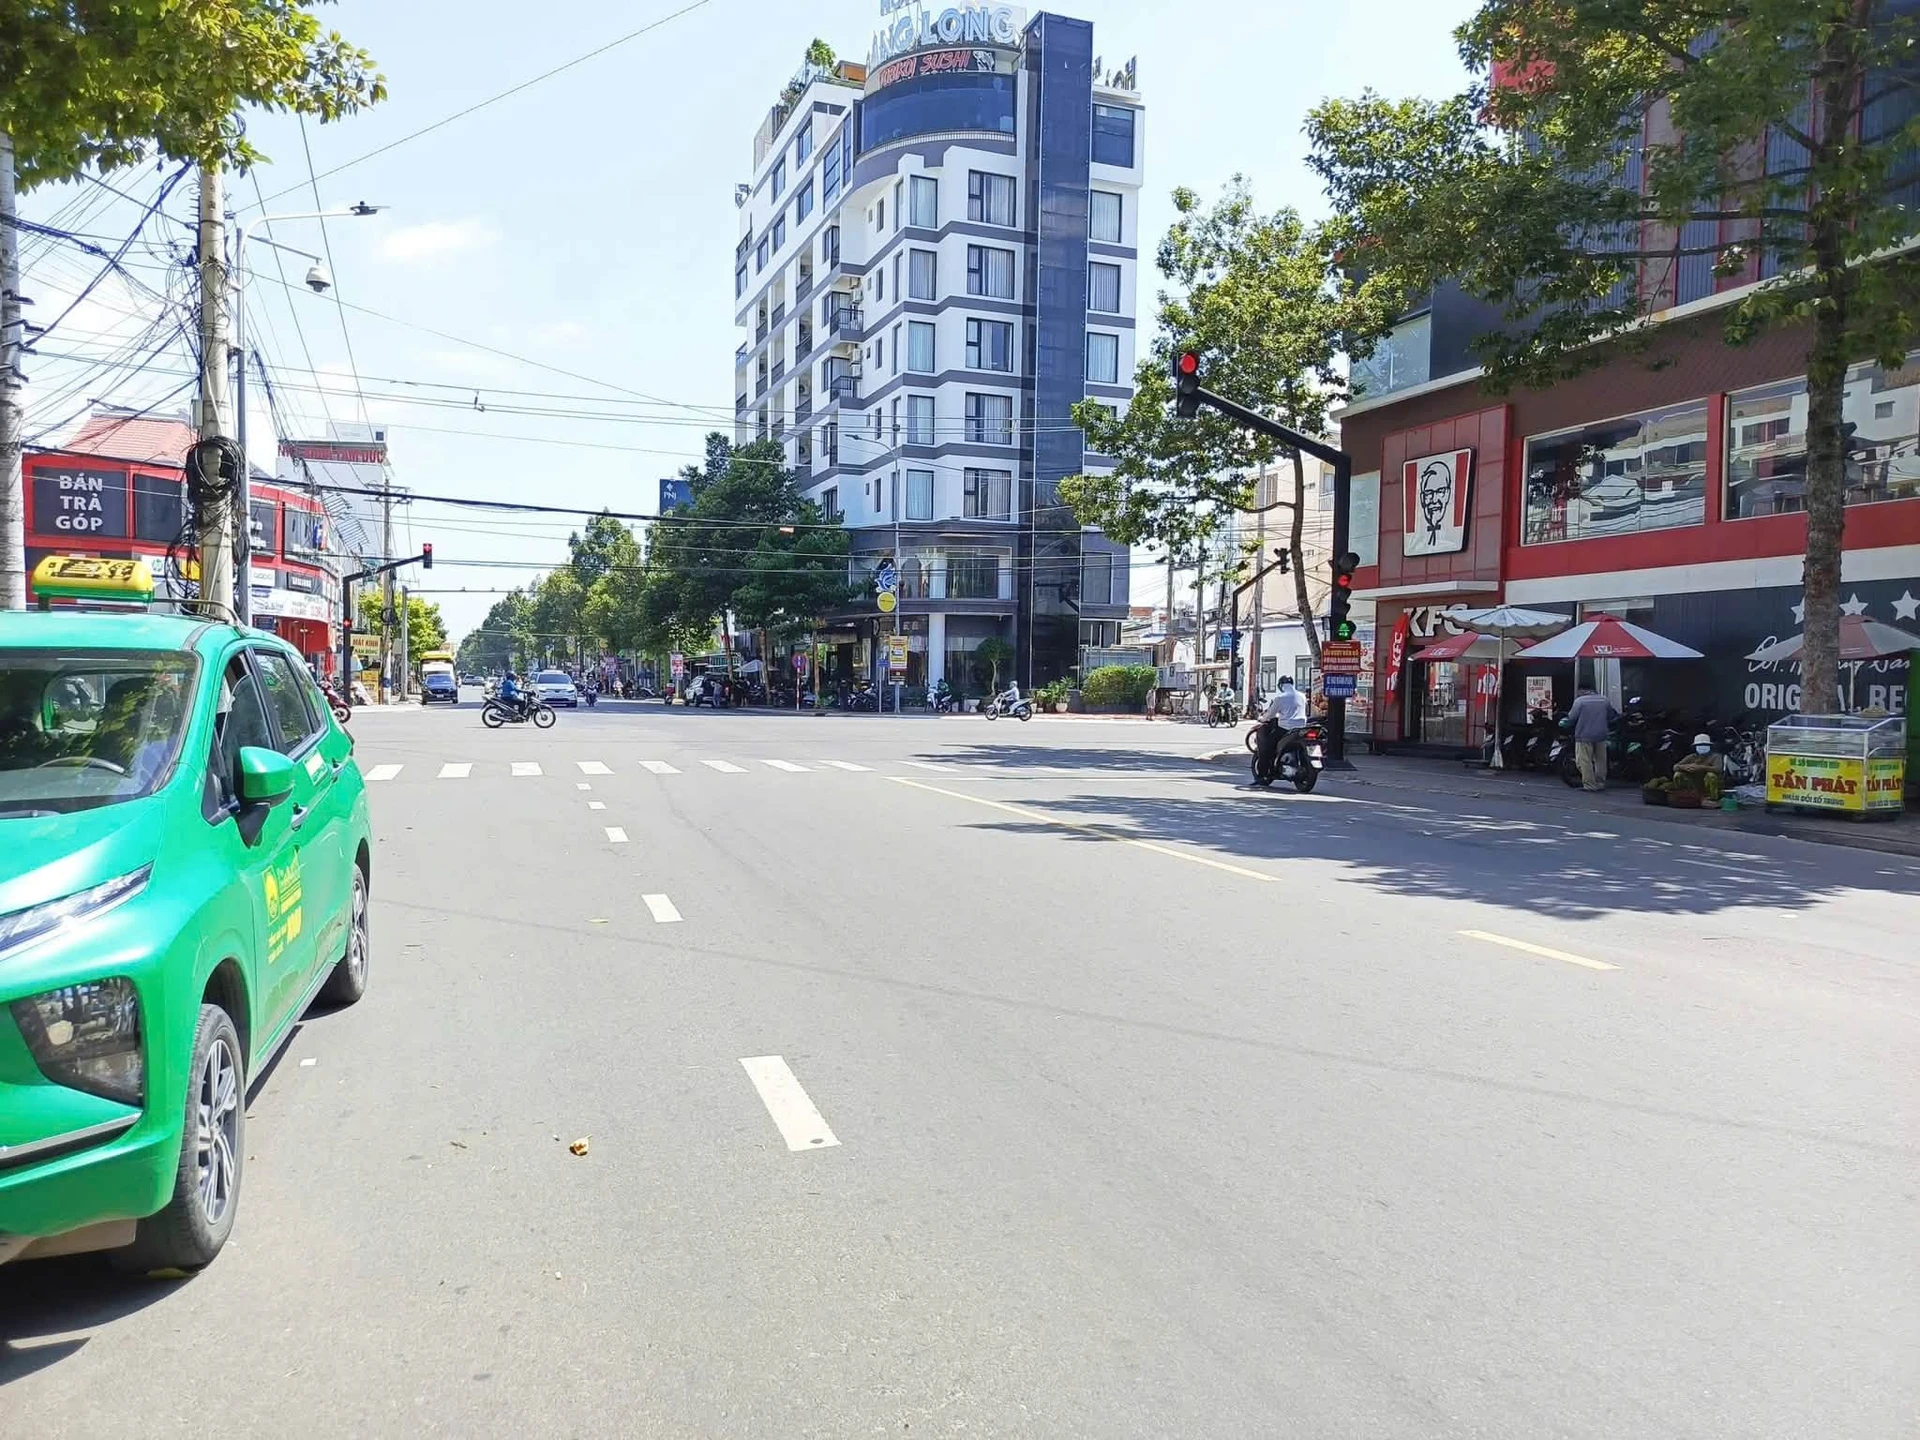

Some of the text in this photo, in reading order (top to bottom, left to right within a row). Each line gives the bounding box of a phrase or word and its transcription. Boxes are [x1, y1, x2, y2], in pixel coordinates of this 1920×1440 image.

[921, 7, 1014, 45] LONG
[920, 51, 971, 72] SUSHI
[59, 472, 103, 492] BÁN
[60, 493, 103, 511] TRẢ
[55, 513, 103, 531] GÓP
[1392, 632, 1403, 667] KFC
[1810, 774, 1857, 795] PHÁT
